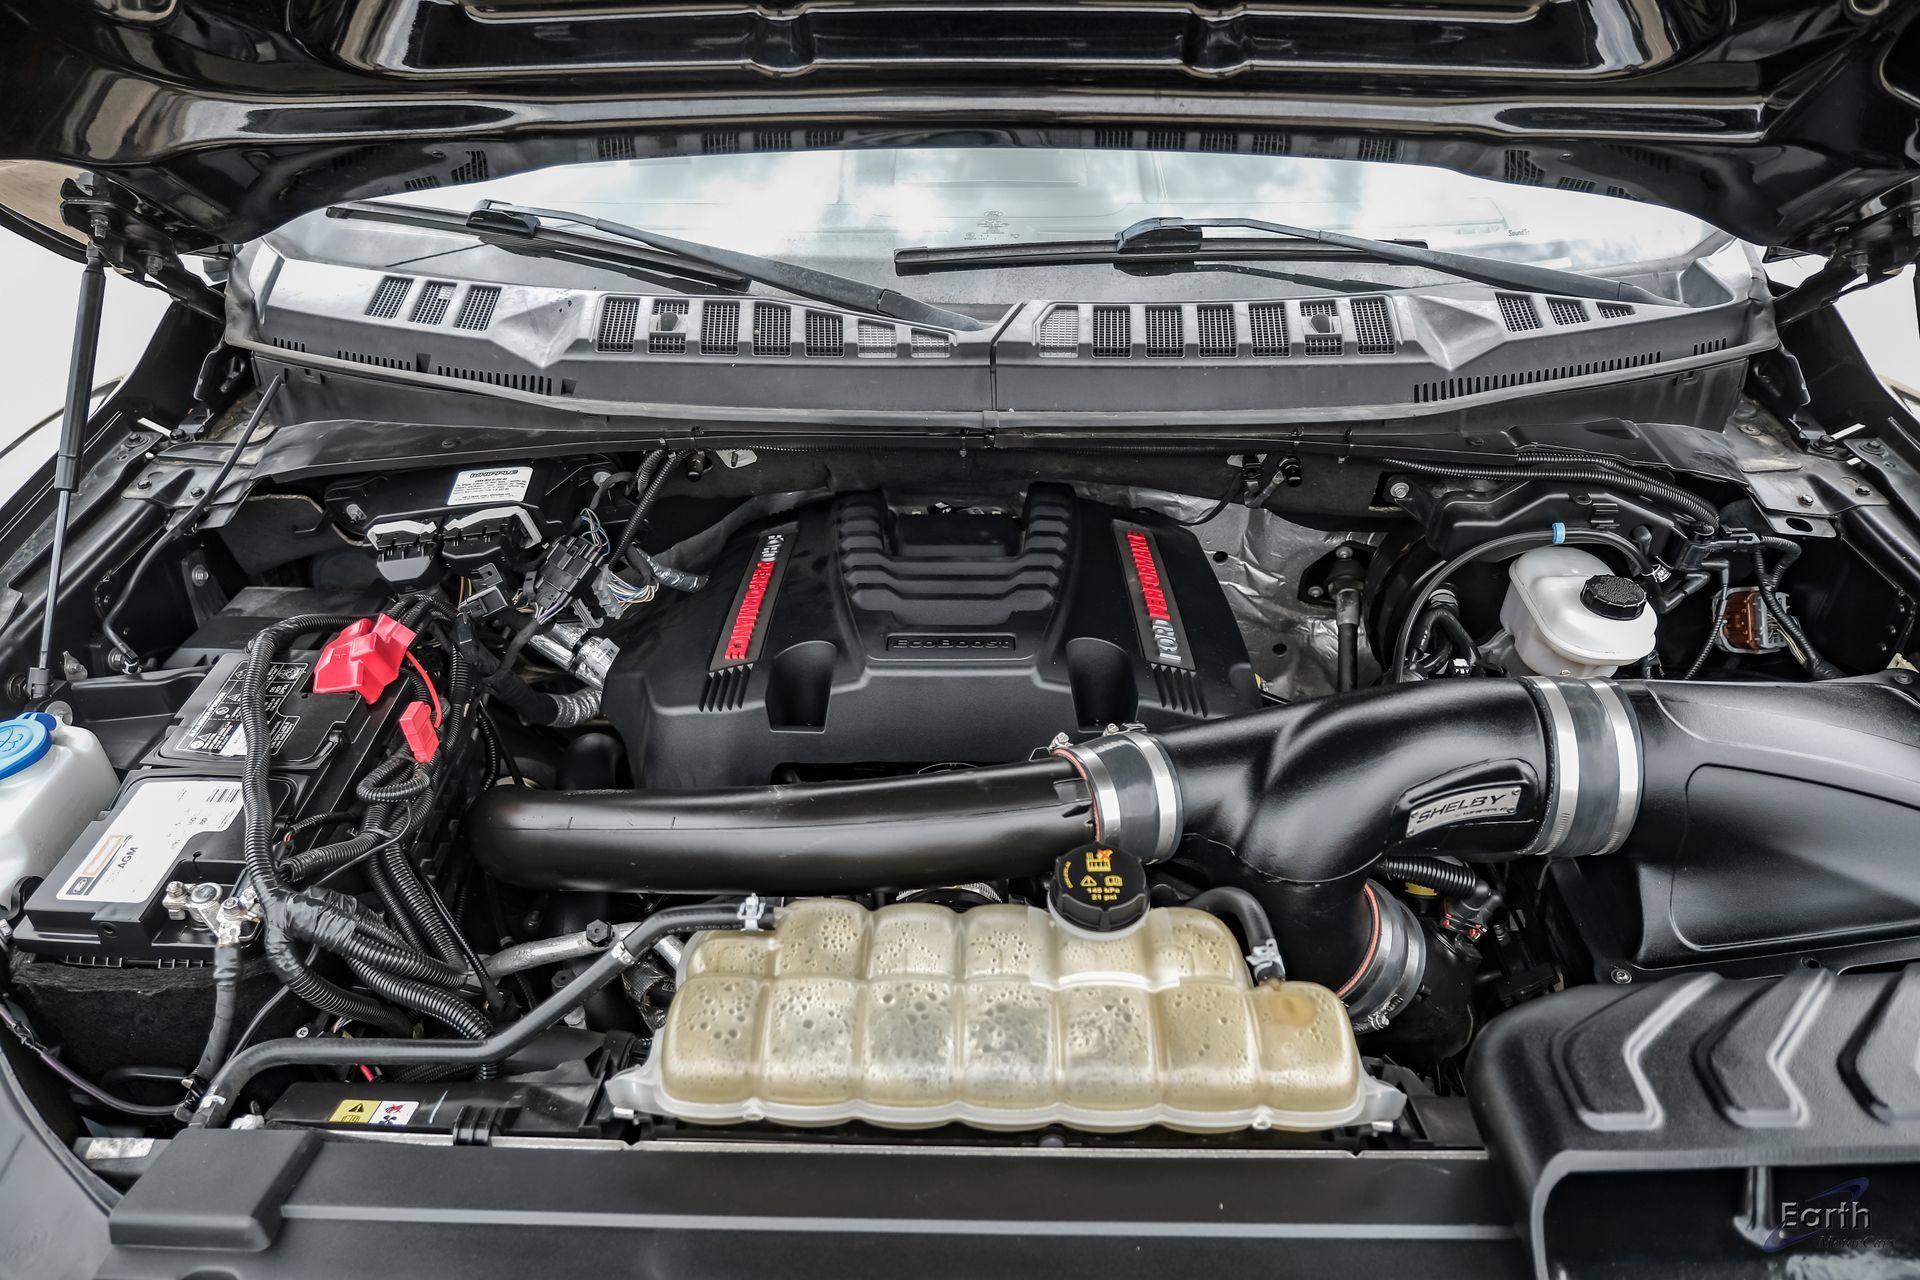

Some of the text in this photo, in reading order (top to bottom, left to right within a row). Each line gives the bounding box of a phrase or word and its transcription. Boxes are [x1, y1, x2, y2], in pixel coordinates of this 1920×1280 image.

[724, 561, 775, 660] PERFORMANCE
[1126, 530, 1182, 662] FORD PERFORMANCE
[1416, 794, 1506, 824] SHELBY
[117, 847, 139, 869] AGM
